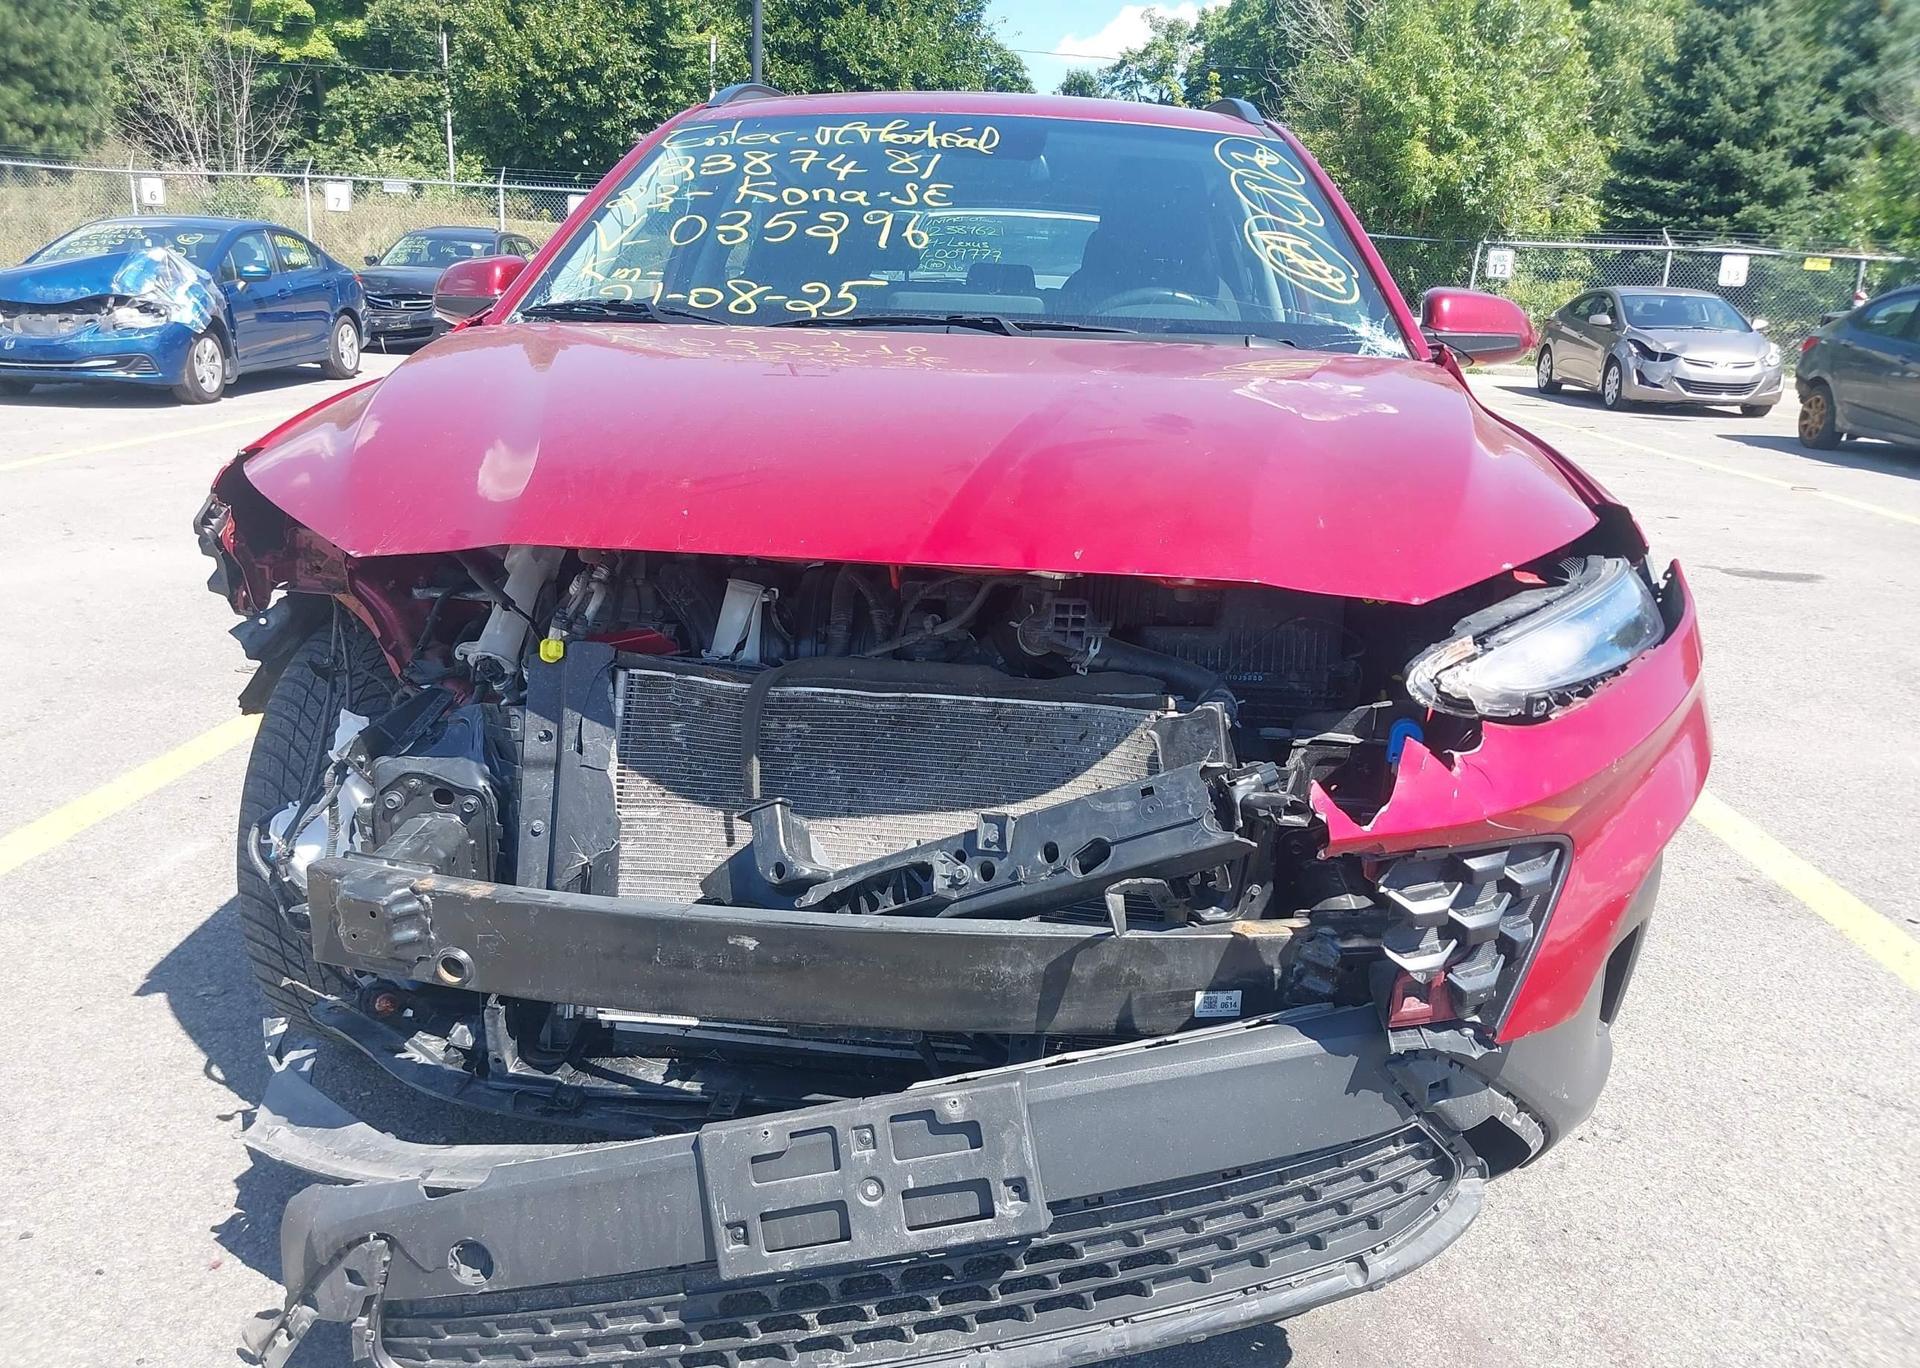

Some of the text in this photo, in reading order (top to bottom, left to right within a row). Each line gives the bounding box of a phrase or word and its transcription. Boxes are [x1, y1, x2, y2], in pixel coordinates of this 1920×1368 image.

[150, 190, 157, 200] 6
[334, 197, 341, 208] 7
[1493, 263, 1506, 275] 12
[1727, 270, 1740, 281] 13
[1220, 1001, 1237, 1009] 0614
